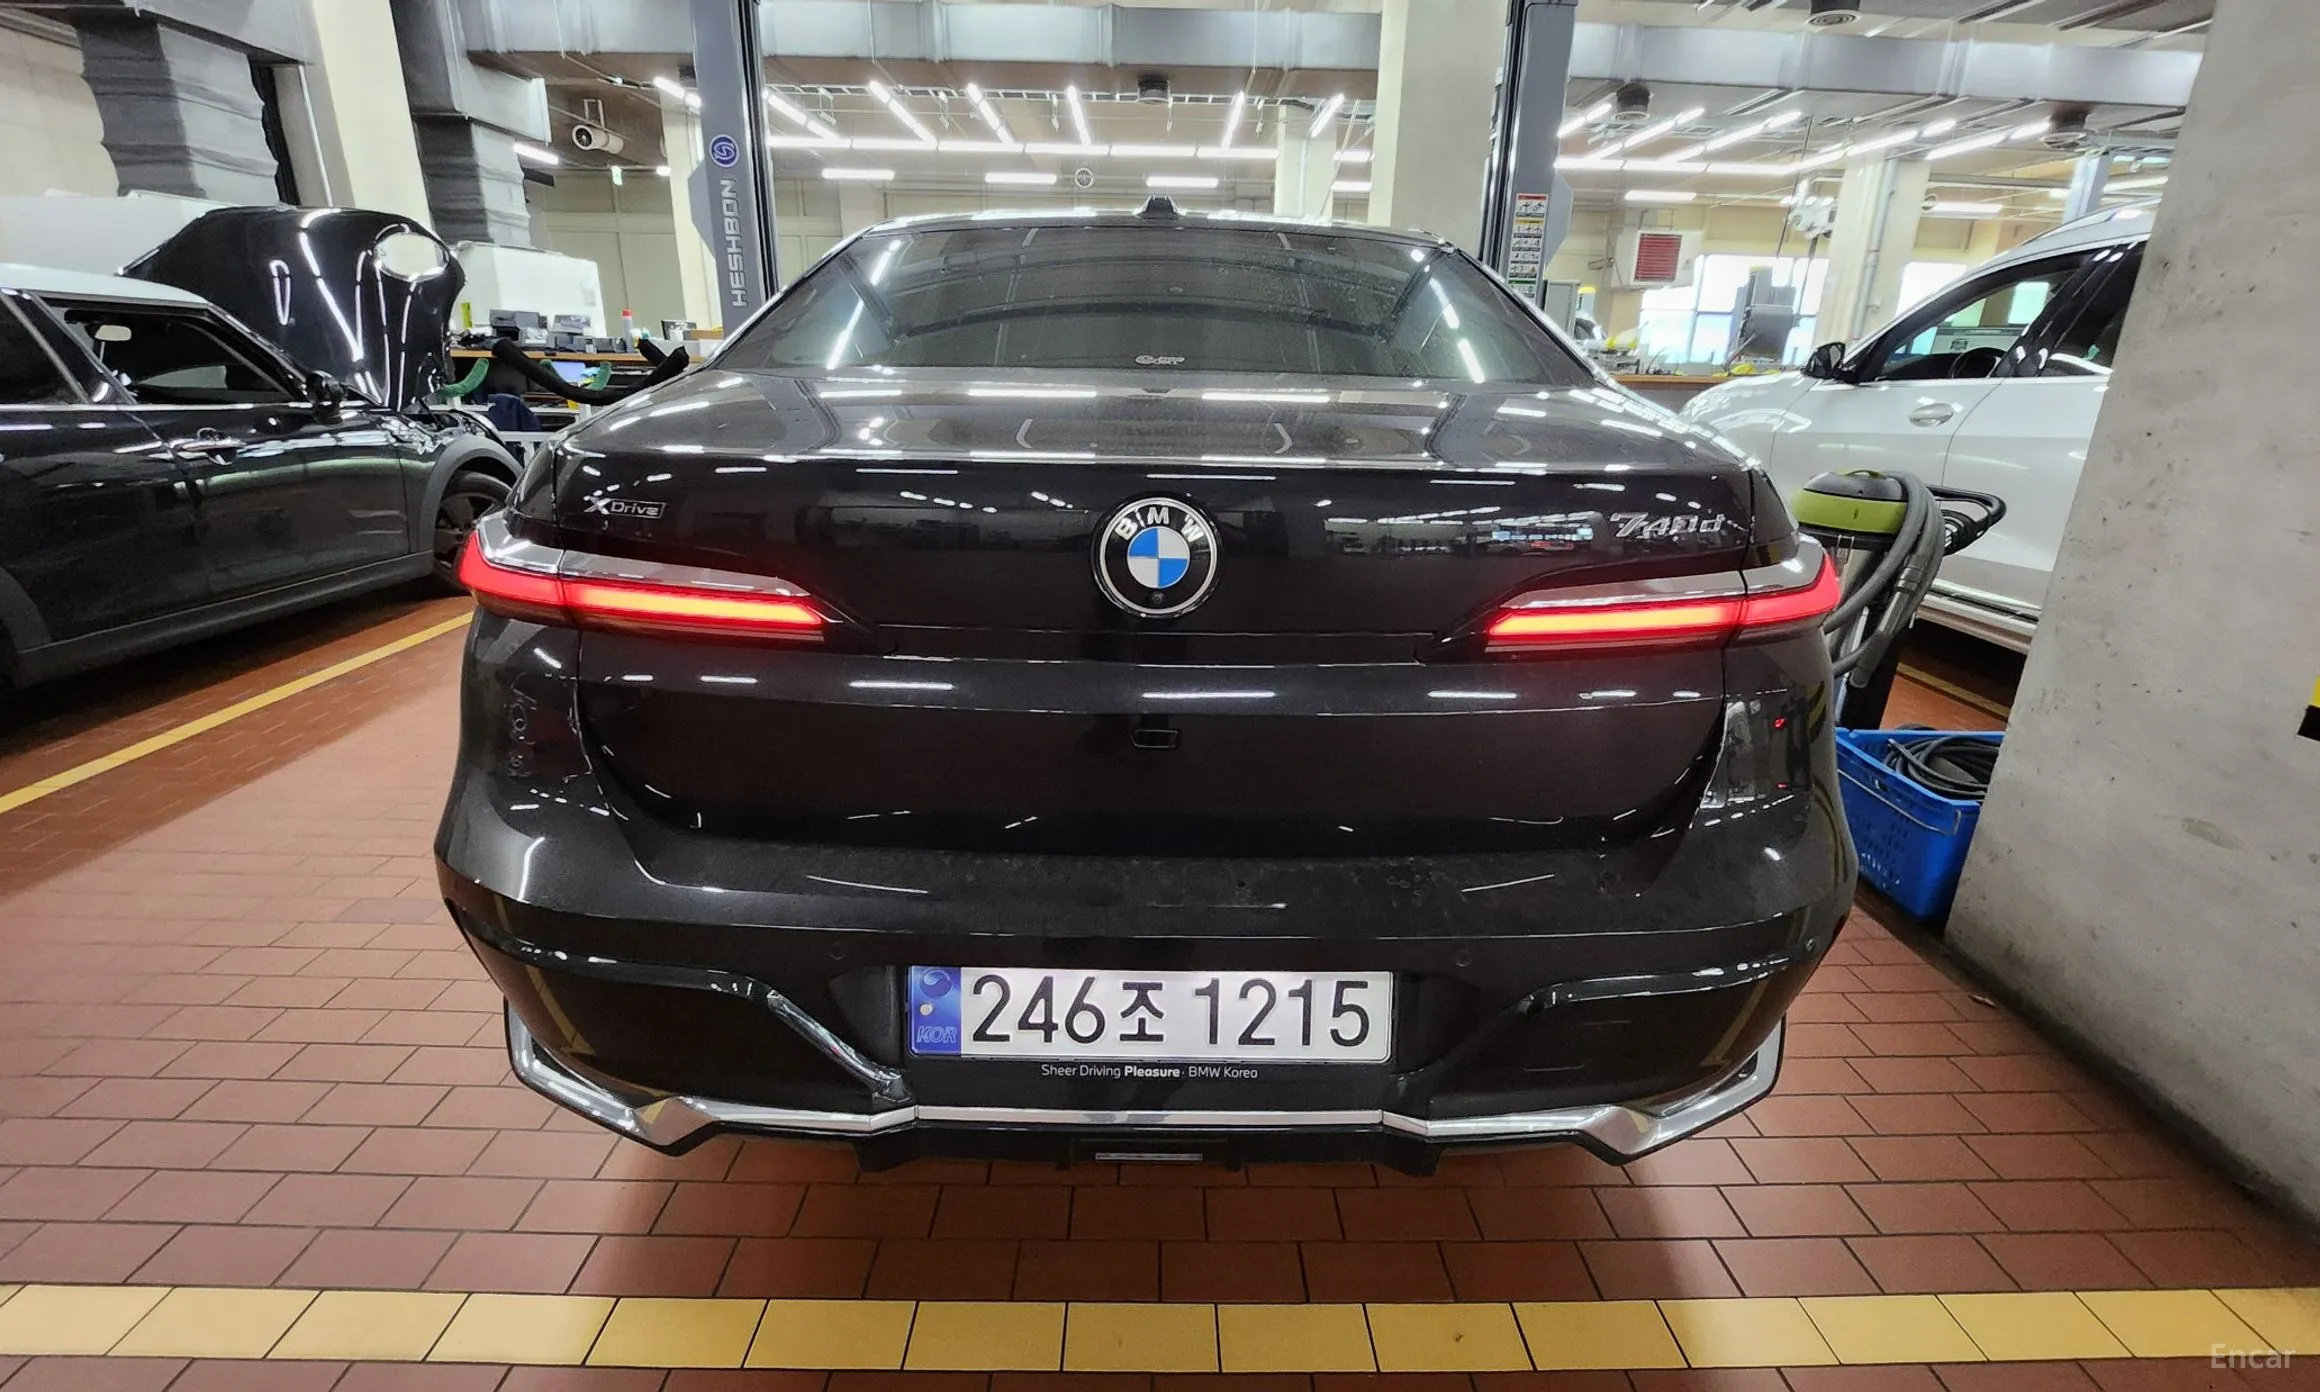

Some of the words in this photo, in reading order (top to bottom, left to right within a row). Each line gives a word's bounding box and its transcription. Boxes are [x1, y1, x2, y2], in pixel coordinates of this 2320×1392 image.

[720, 178, 747, 307] HESHBON
[1114, 506, 1204, 543] BMW
[1610, 512, 1725, 538] 740d
[972, 974, 1164, 1044] 246조
[1194, 977, 1370, 1047] 1215
[916, 1025, 956, 1044] KOR
[1041, 1064, 1077, 1077] Sheer
[1079, 1064, 1121, 1079] Driving
[1123, 1065, 1181, 1078] Pleasure
[1188, 1066, 1220, 1078] BMW
[1223, 1066, 1258, 1079] Korea
